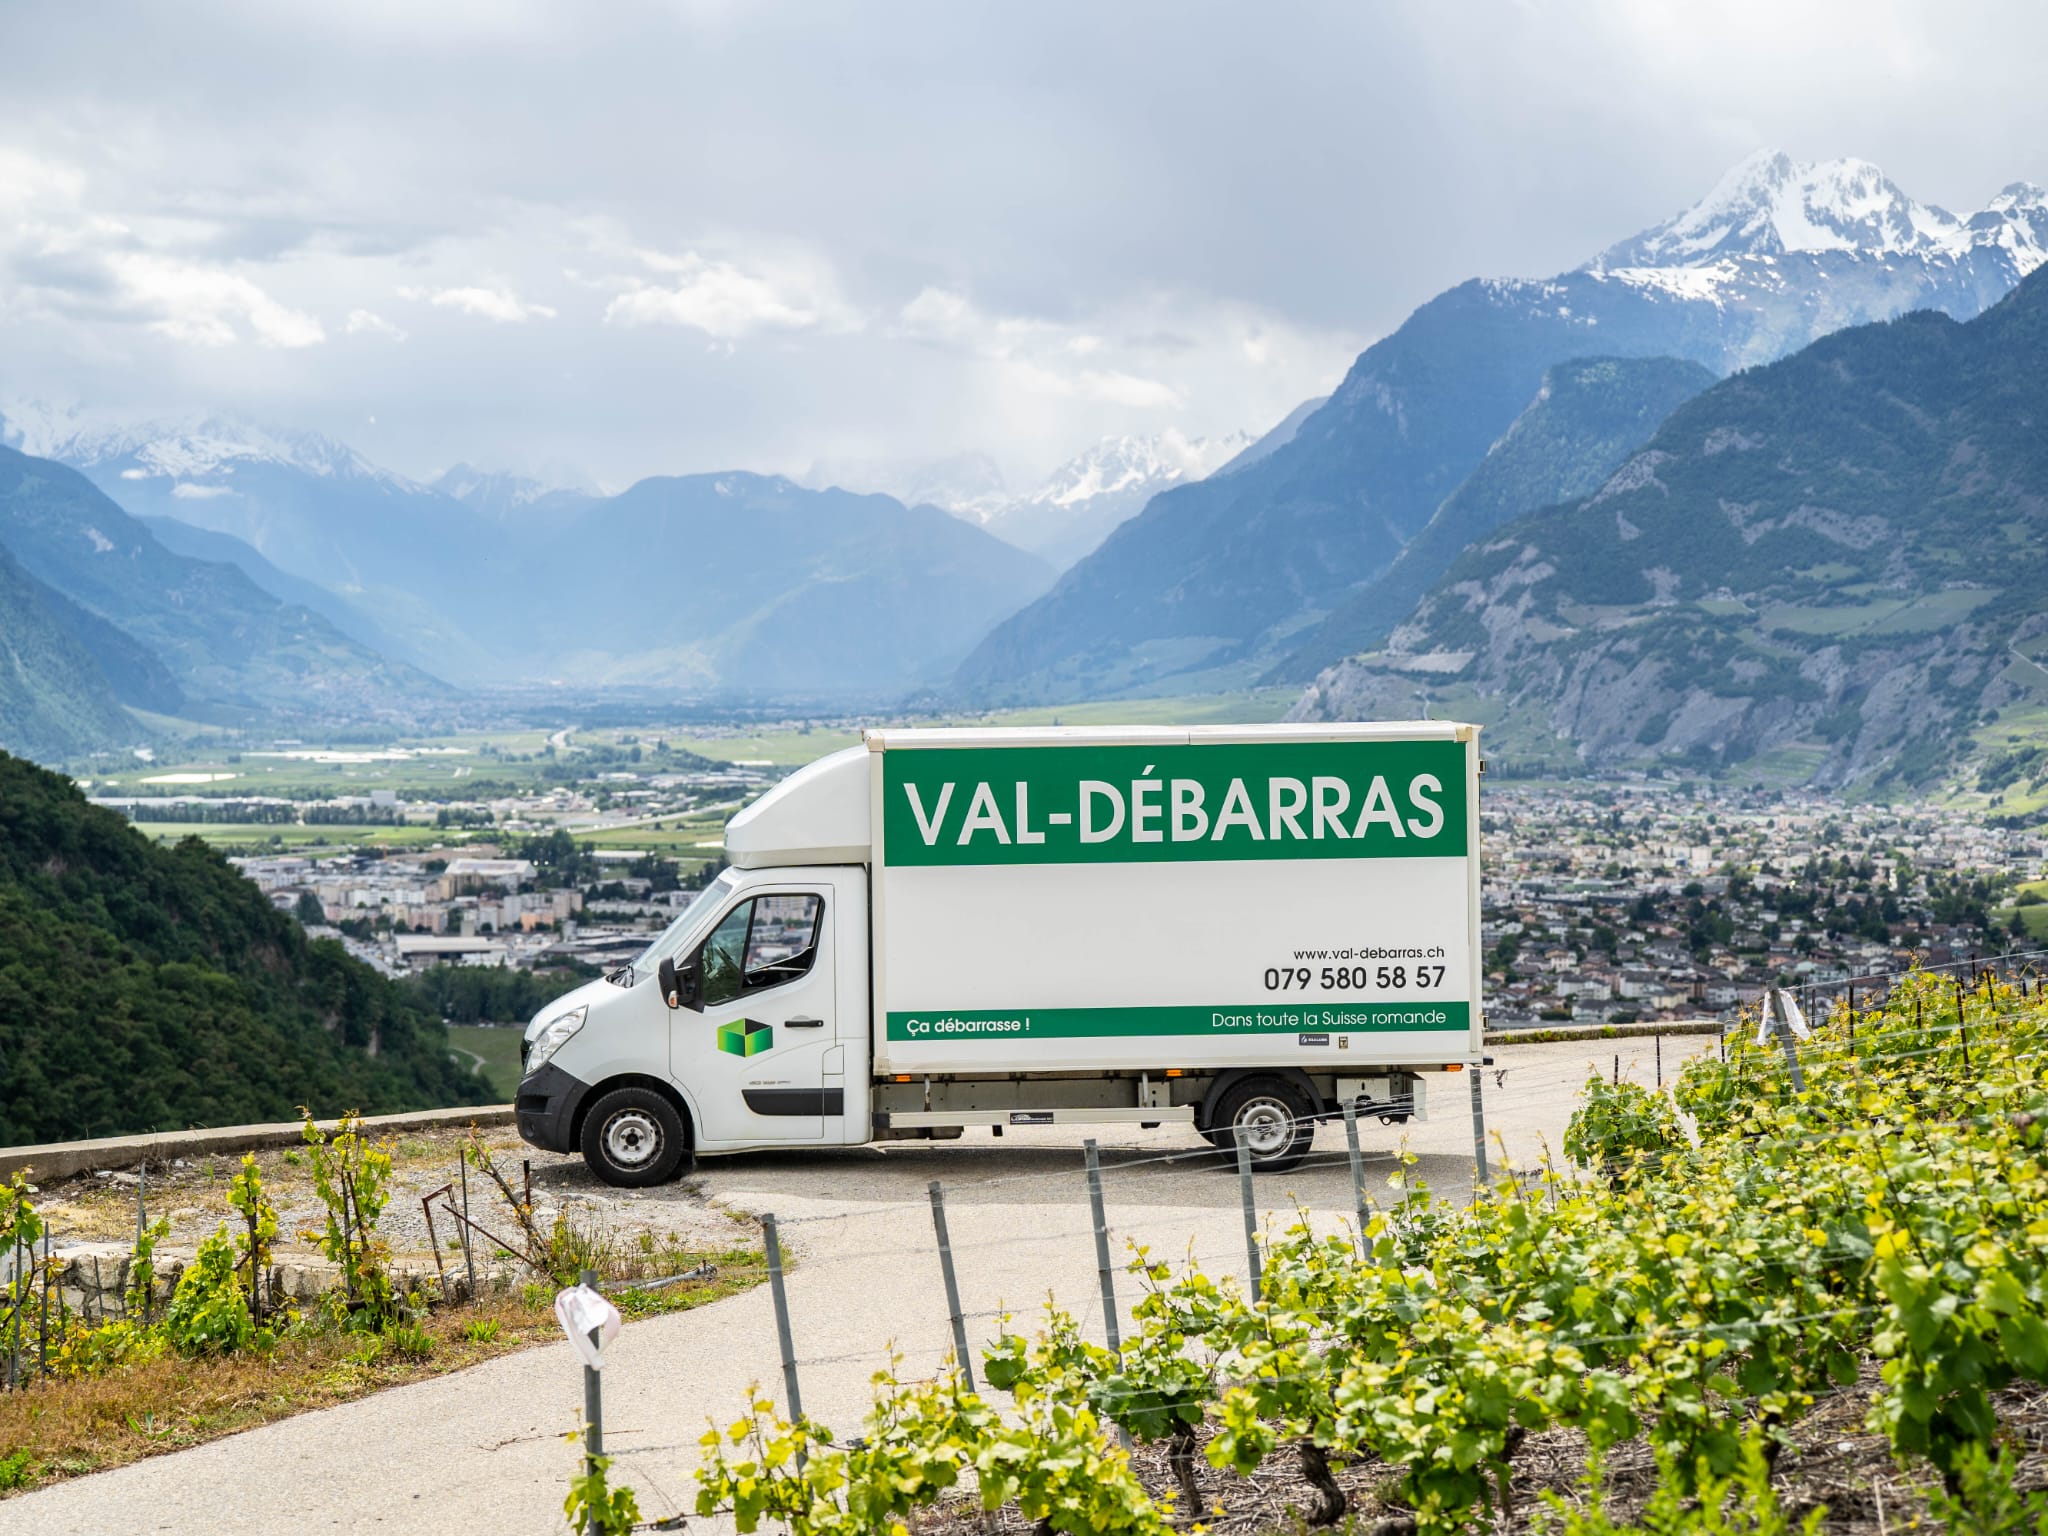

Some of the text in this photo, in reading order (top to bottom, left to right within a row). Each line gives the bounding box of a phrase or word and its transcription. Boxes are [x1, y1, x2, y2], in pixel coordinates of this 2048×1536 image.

[903, 764, 1444, 846] VAL-DÉBARRAS
[1293, 946, 1445, 960] www.val-debarras.ch
[1264, 965, 1446, 991] 079 580 58 57
[906, 1019, 930, 1036] Ça
[934, 1017, 1021, 1033] débarrasse
[1212, 1009, 1447, 1027] Dans toute la Suisse romande
